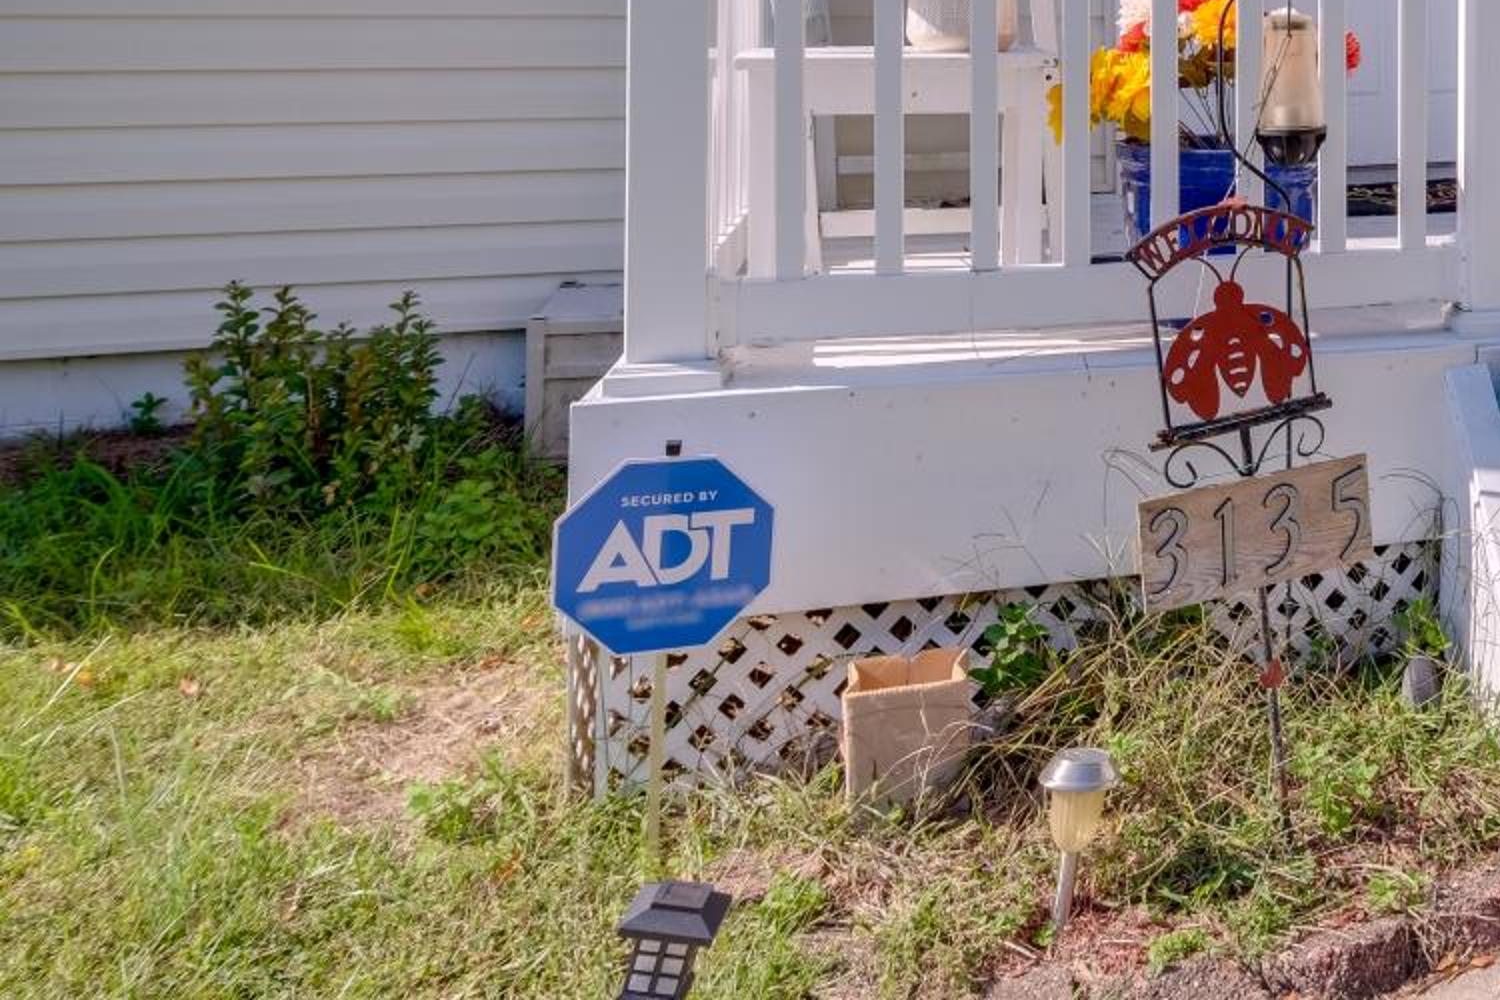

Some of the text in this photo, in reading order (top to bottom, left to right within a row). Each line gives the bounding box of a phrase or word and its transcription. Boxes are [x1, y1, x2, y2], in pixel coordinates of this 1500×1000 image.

[1136, 207, 1311, 277] WELCOME
[621, 490, 718, 507] SECURED BY
[1148, 463, 1366, 596] 3135
[576, 509, 755, 592] ADT
